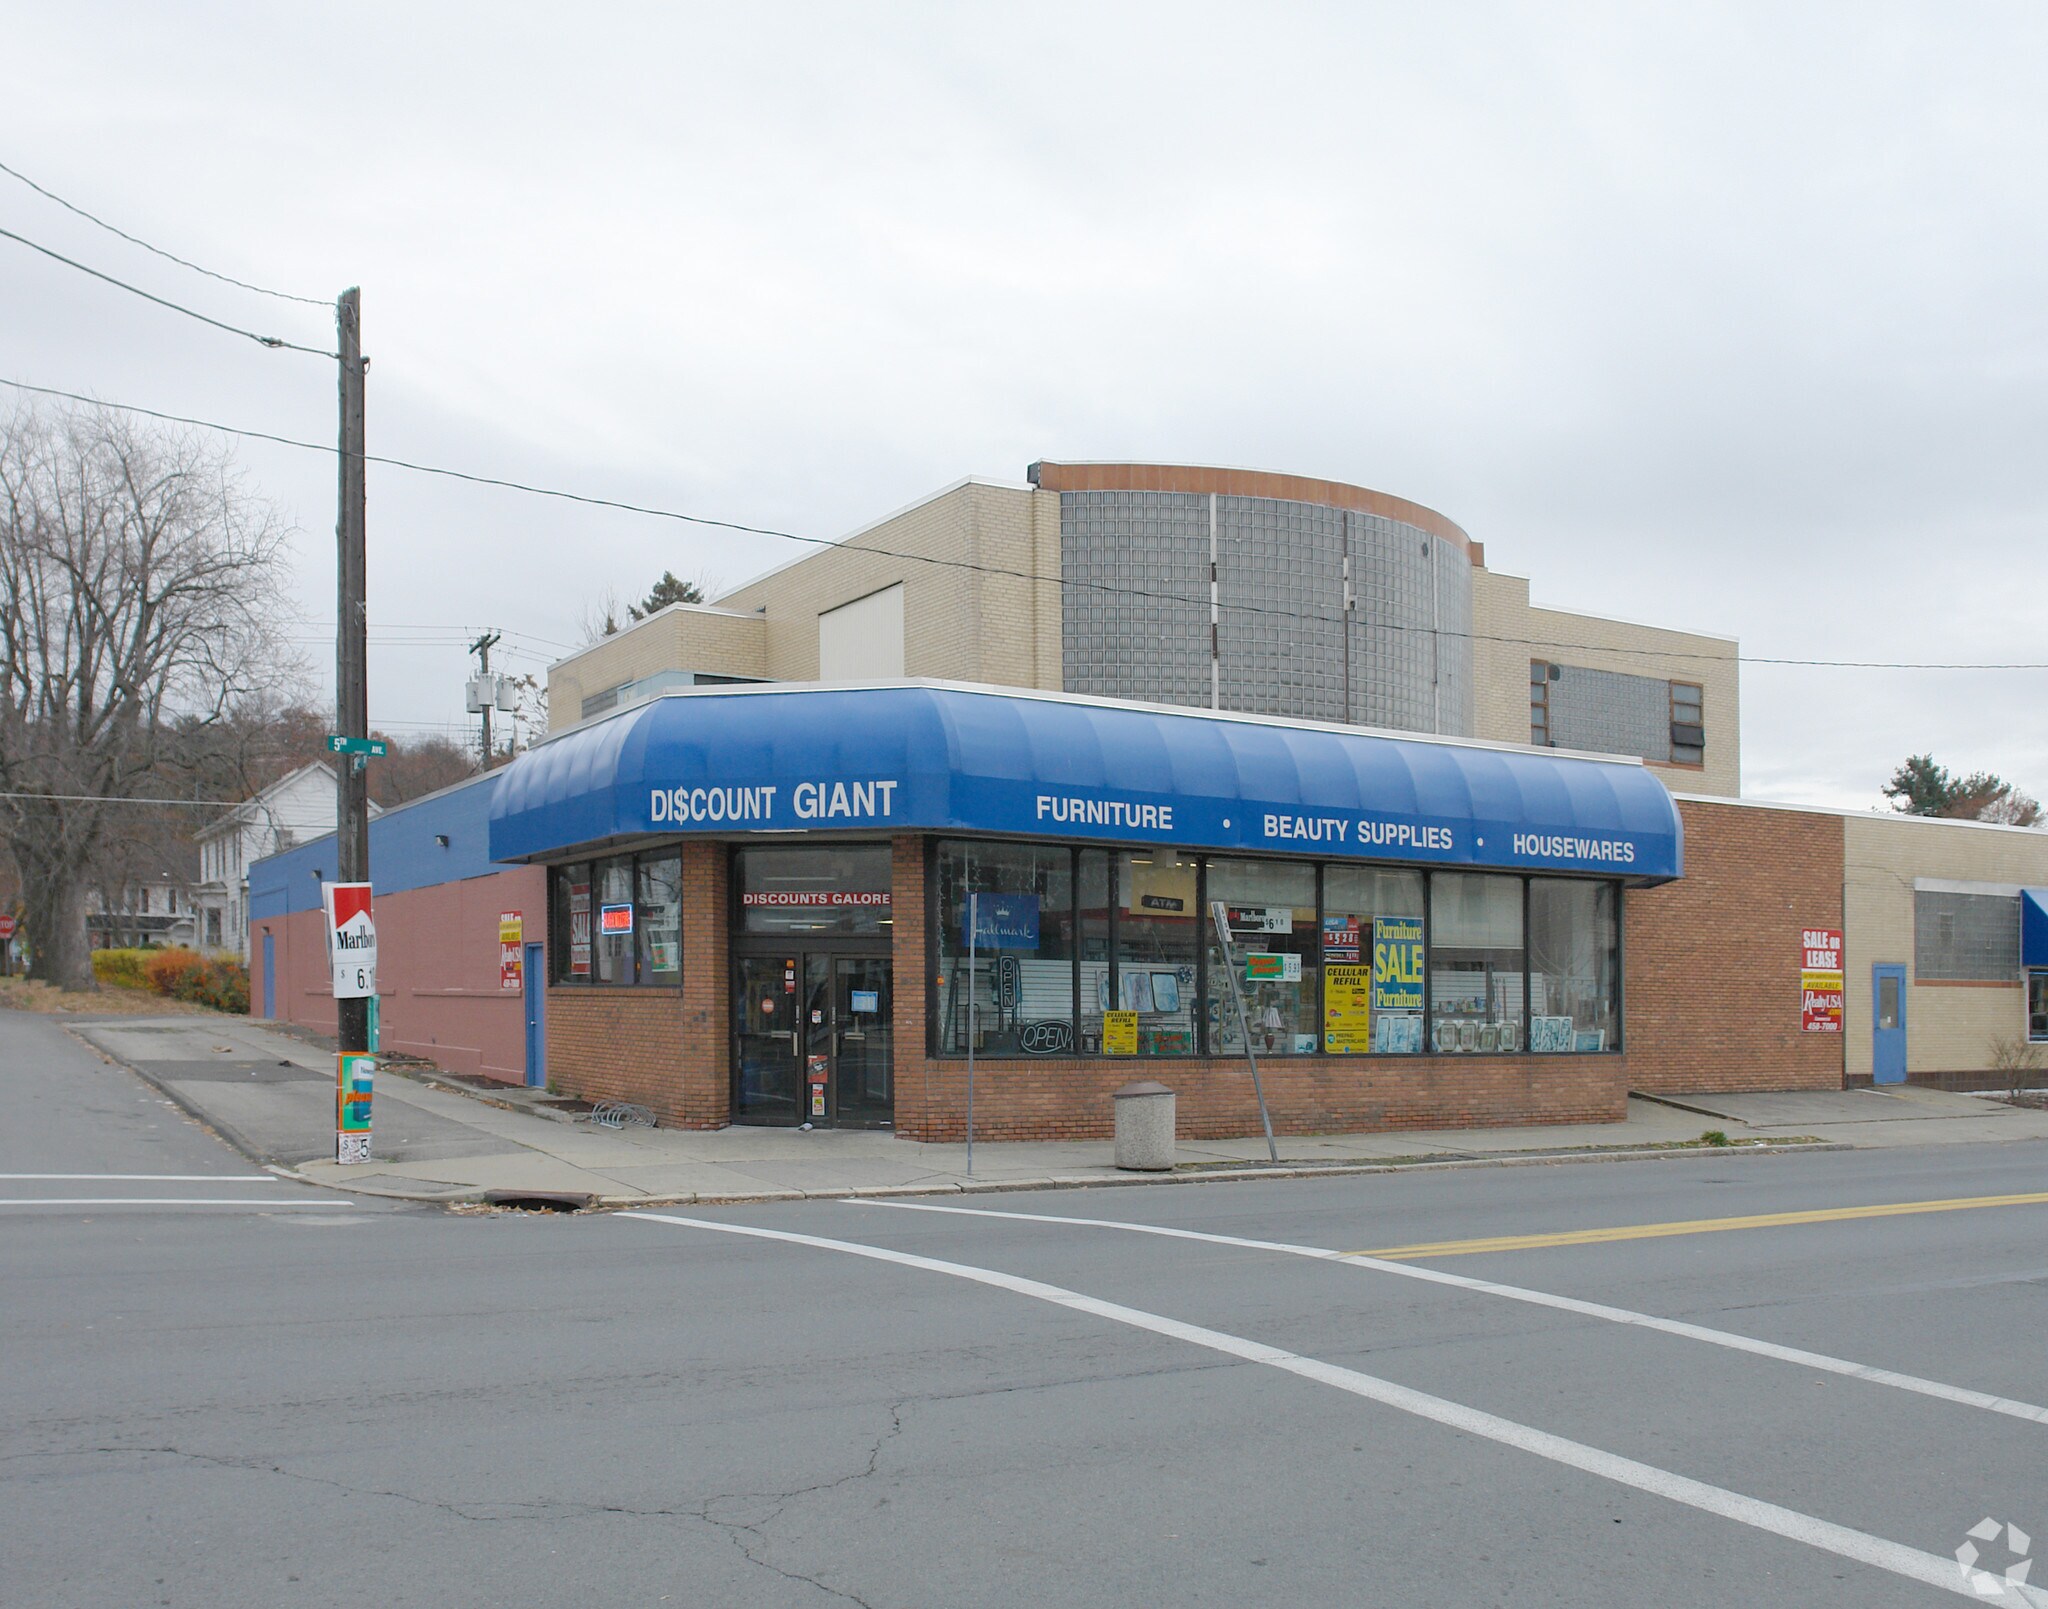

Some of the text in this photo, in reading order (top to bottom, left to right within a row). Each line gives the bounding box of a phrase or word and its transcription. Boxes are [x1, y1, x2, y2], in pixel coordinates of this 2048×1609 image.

[333, 737, 347, 752] 5TH
[651, 780, 898, 825] DI$COUNT GIANT
[1036, 795, 1174, 830] FURNITURE
[1263, 814, 1453, 850] BEAUTY SUPPLIES
[1513, 833, 1635, 863] HOUSEWARES
[743, 893, 891, 905] DISCOUNTS GALORE
[1151, 897, 1177, 909] ATM
[1376, 919, 1422, 940] Furniture
[1803, 931, 1841, 950] SALE OR
[1375, 943, 1423, 983] SALE
[1807, 950, 1838, 968] LEASE
[1327, 967, 1369, 976] CELLULAR
[1333, 977, 1361, 986] REFILL
[1002, 959, 1013, 1006] OPEN
[1806, 981, 1840, 990] AVAILABLE
[1376, 987, 1422, 1008] Furniture
[1023, 1026, 1069, 1049] OPEN
